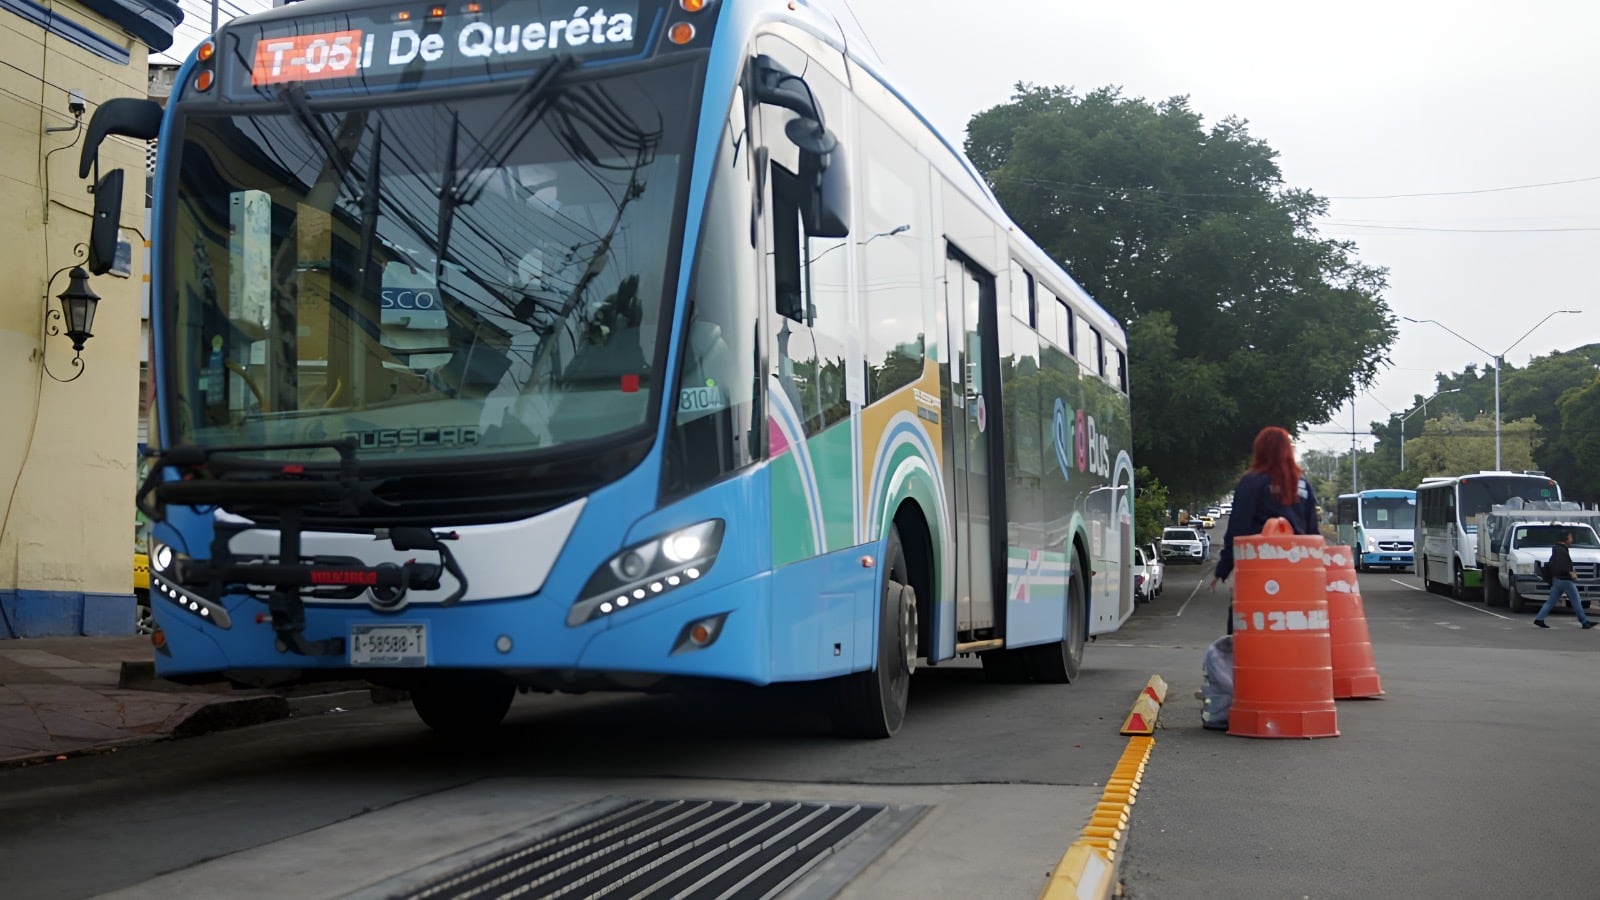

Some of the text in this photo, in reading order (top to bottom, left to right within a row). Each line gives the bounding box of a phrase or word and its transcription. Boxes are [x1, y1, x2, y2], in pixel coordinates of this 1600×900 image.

[266, 36, 353, 77] T-05
[388, 29, 444, 65] De
[457, 5, 633, 58] Queréta
